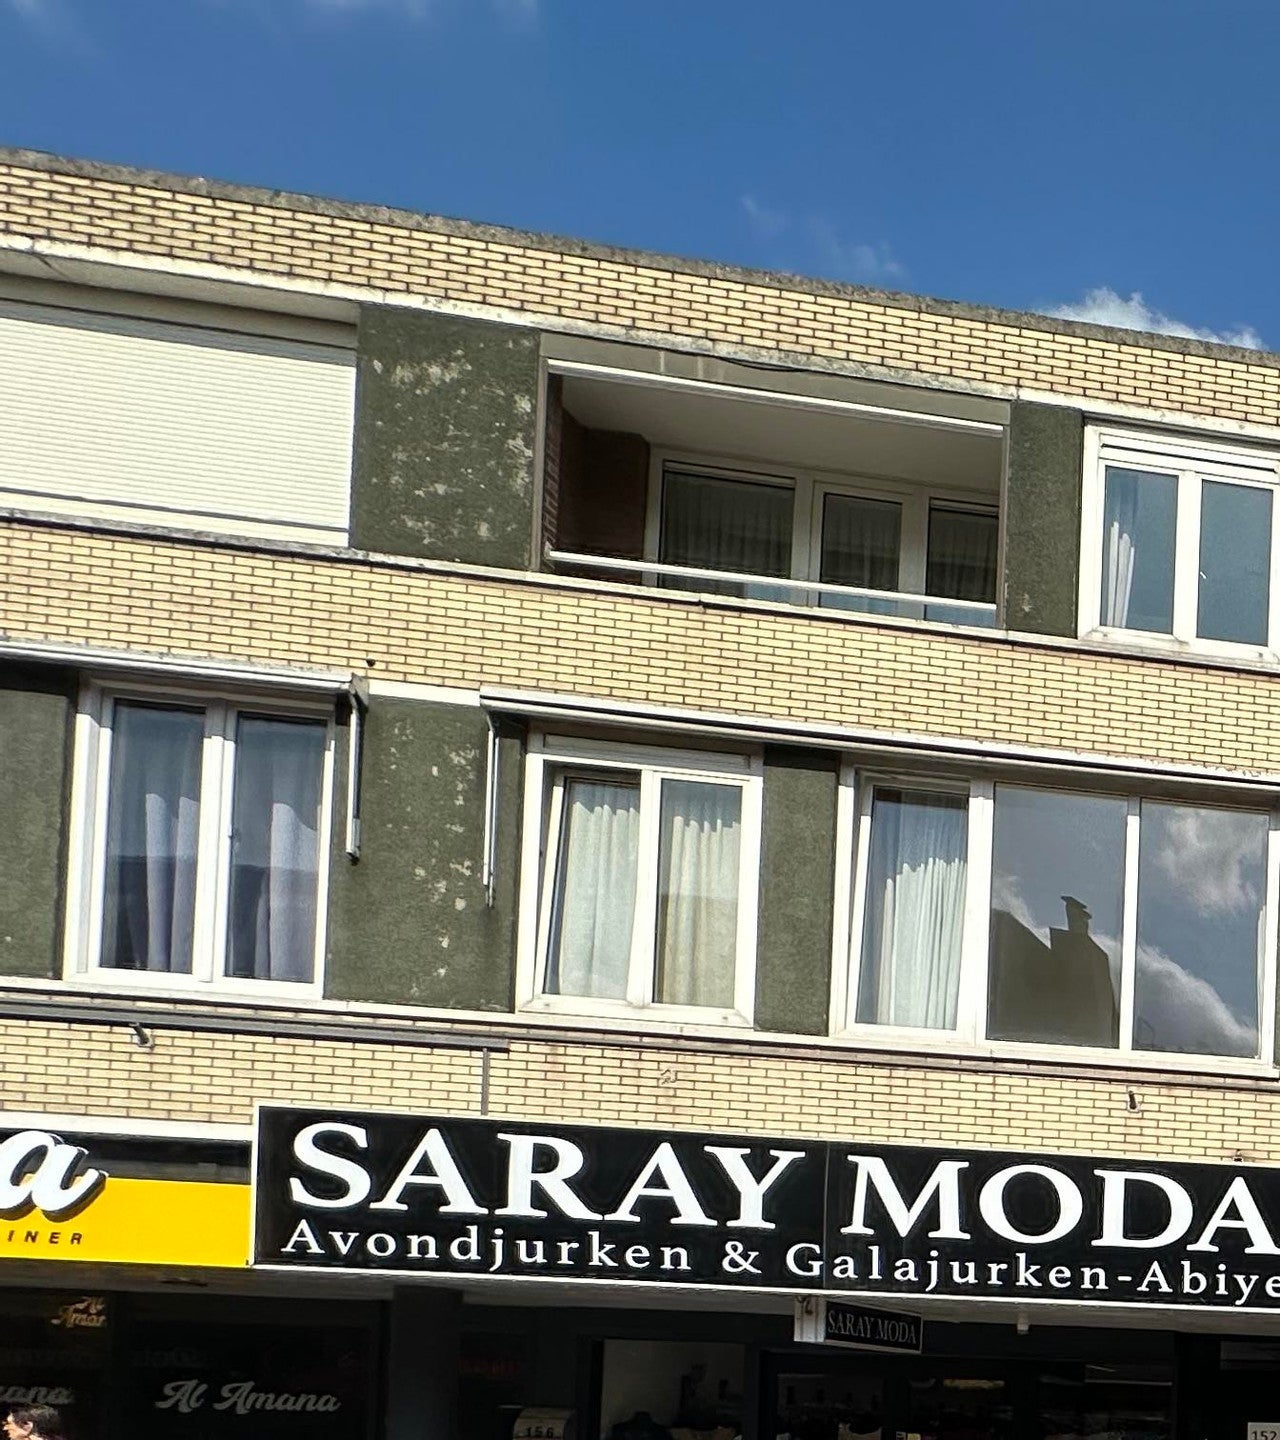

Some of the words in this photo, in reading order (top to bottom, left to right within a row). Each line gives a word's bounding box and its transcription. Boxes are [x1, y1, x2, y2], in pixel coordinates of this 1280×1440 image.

[290, 1120, 806, 1231] SARAY
[281, 1217, 691, 1272] Avondjurken
[722, 1239, 763, 1275] &
[827, 1309, 876, 1340] SARAY
[874, 1319, 918, 1345] MODA
[0, 1386, 76, 1405] ana
[154, 1379, 209, 1413] Al
[212, 1380, 342, 1415] Amana
[525, 1426, 554, 1439] 156
